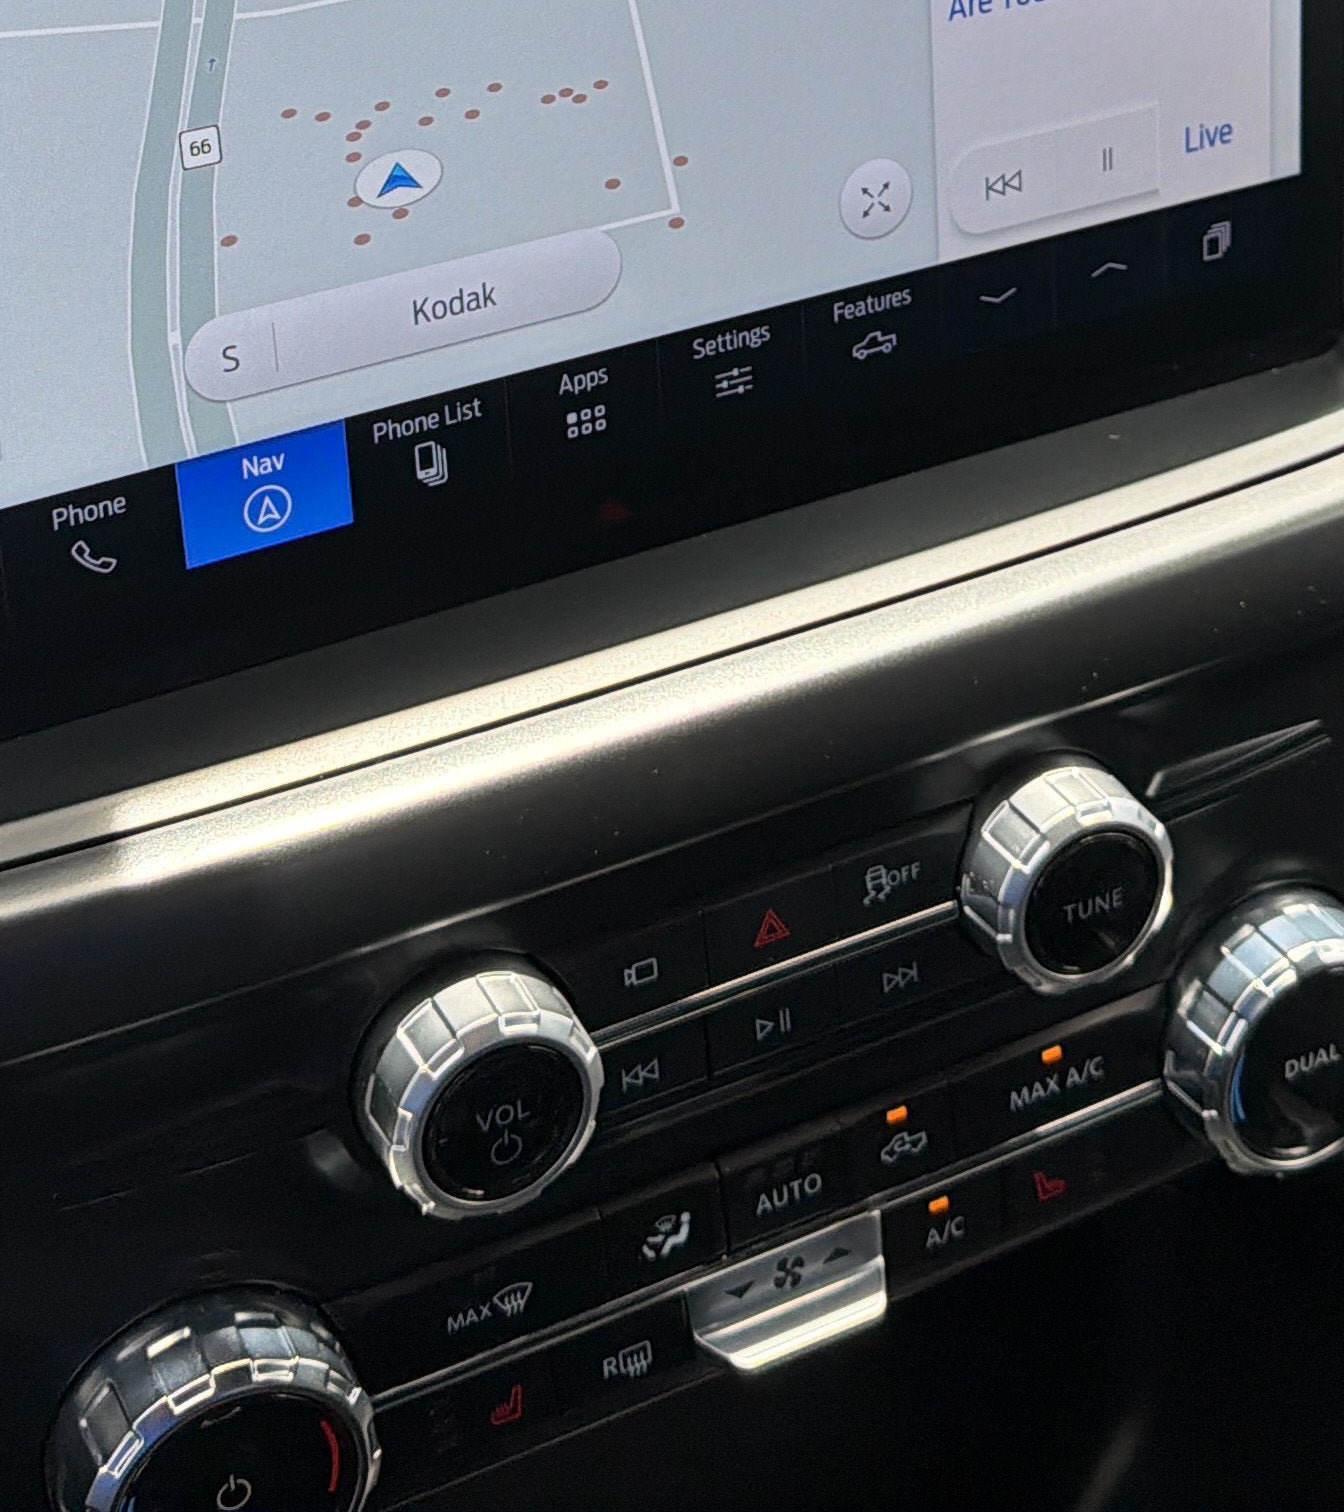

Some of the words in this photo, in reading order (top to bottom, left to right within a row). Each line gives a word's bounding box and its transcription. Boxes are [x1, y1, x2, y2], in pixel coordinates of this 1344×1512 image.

[189, 138, 212, 157] 66
[1185, 120, 1233, 153] Live
[413, 284, 496, 325] Kodak
[833, 287, 912, 323] Features
[222, 346, 240, 373] S
[693, 325, 771, 360] Settings
[559, 367, 608, 395] Apps
[373, 411, 439, 443] Phone
[447, 398, 482, 425] List
[242, 453, 285, 479] Nav
[52, 496, 126, 530] Phone
[889, 862, 922, 886] OFF
[1063, 889, 1124, 924] TUNE
[1284, 1044, 1341, 1079] DUAL
[1010, 1074, 1059, 1112] MAX
[1065, 1056, 1105, 1089] A/C
[476, 1099, 530, 1134] VOL
[757, 1173, 822, 1216] AUTO
[926, 1217, 965, 1249] A/C
[447, 1302, 493, 1334] MAX
